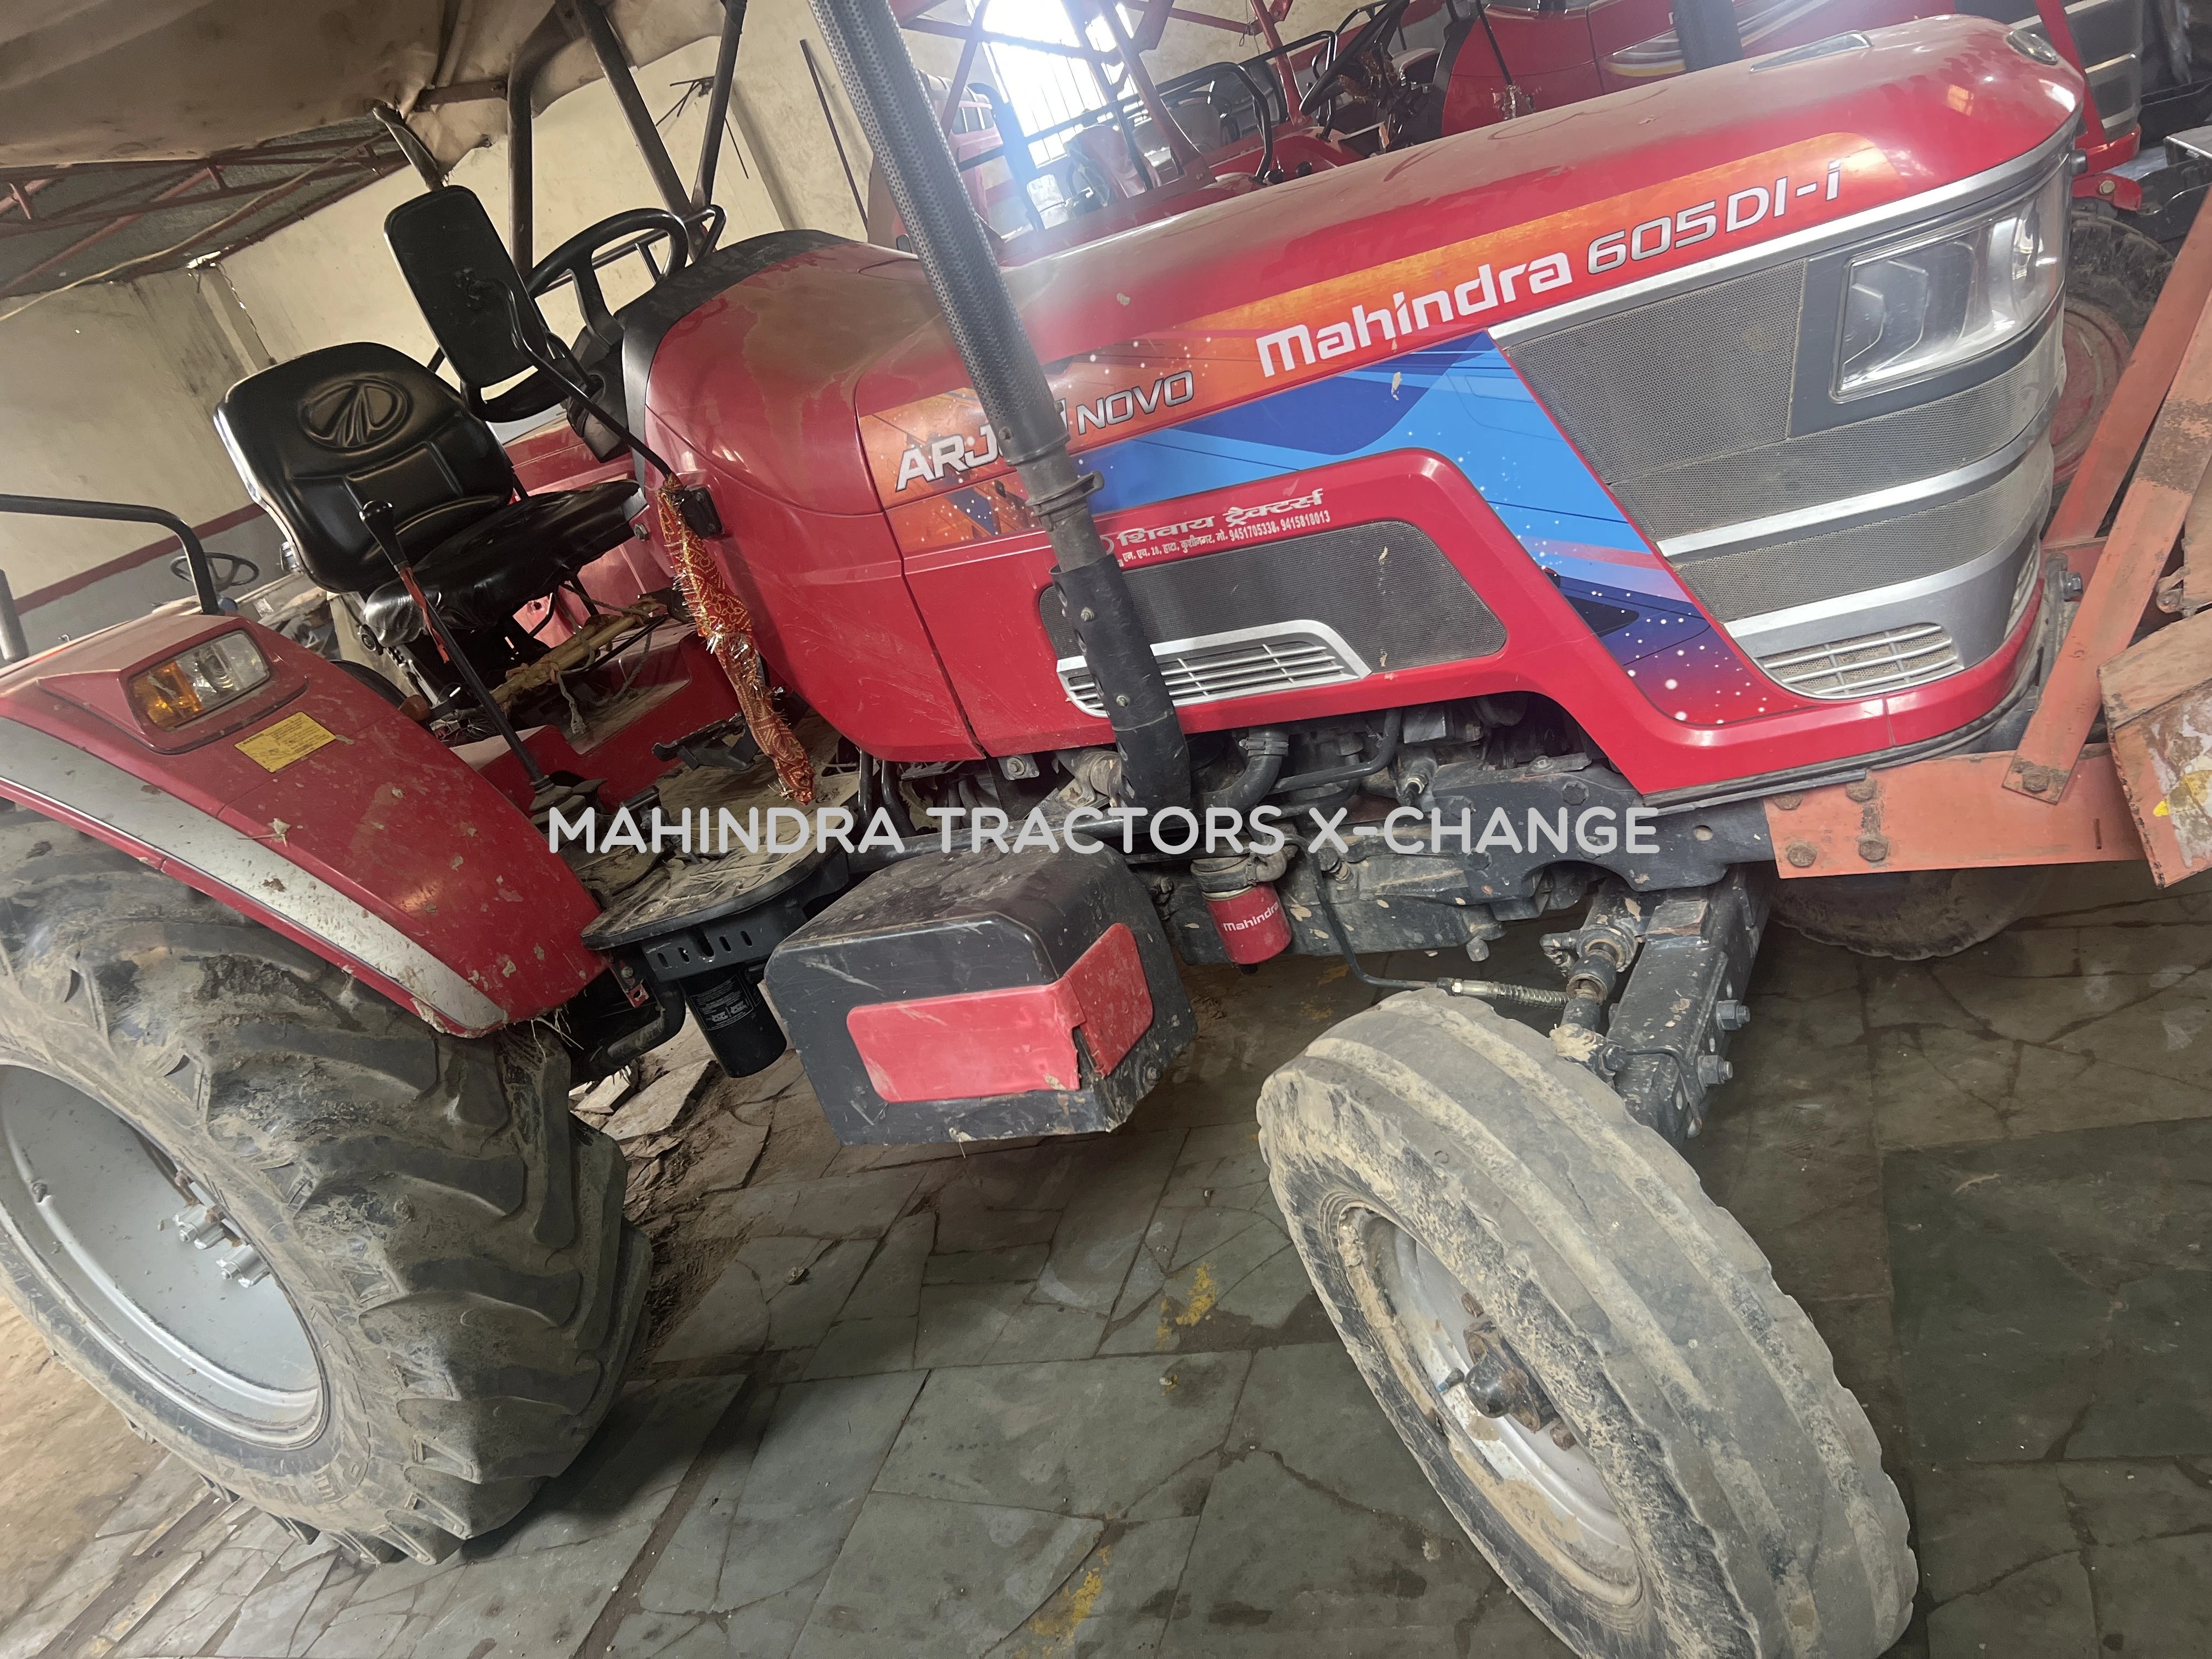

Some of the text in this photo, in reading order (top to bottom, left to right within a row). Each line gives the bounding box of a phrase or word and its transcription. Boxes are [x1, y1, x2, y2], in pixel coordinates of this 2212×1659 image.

[895, 370, 1194, 492] ARJ NOVO
[1116, 516, 1215, 546] शिवाय
[1228, 521, 1279, 542] 9451705338,
[1280, 510, 1331, 532] 9415818013
